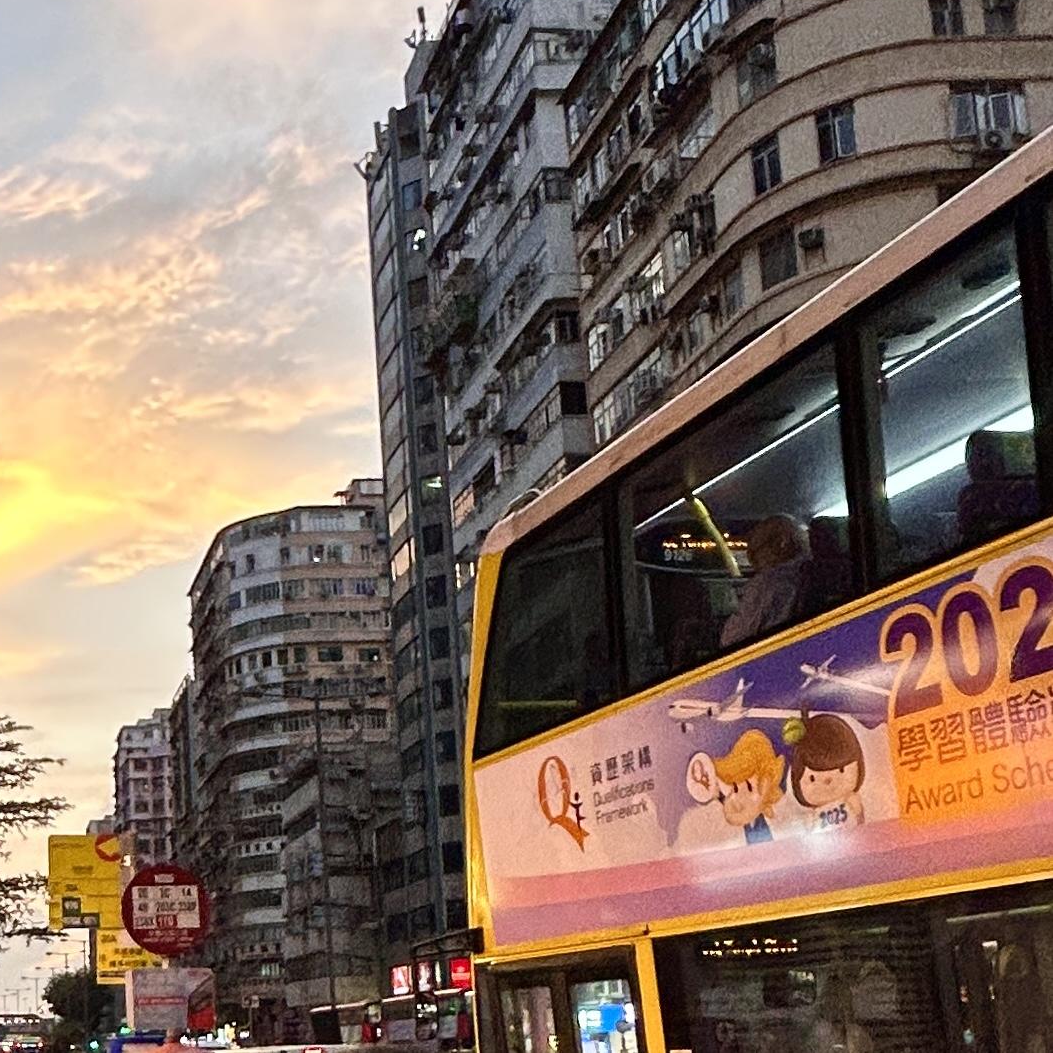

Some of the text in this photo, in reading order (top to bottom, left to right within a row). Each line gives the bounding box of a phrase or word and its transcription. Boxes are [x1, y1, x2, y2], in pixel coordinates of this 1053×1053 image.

[898, 685, 1053, 772] 學習體驗
[593, 779, 655, 807] Qualifications
[905, 769, 984, 814] Award
[595, 798, 648, 825] Framework
[819, 802, 848, 828] 2025
